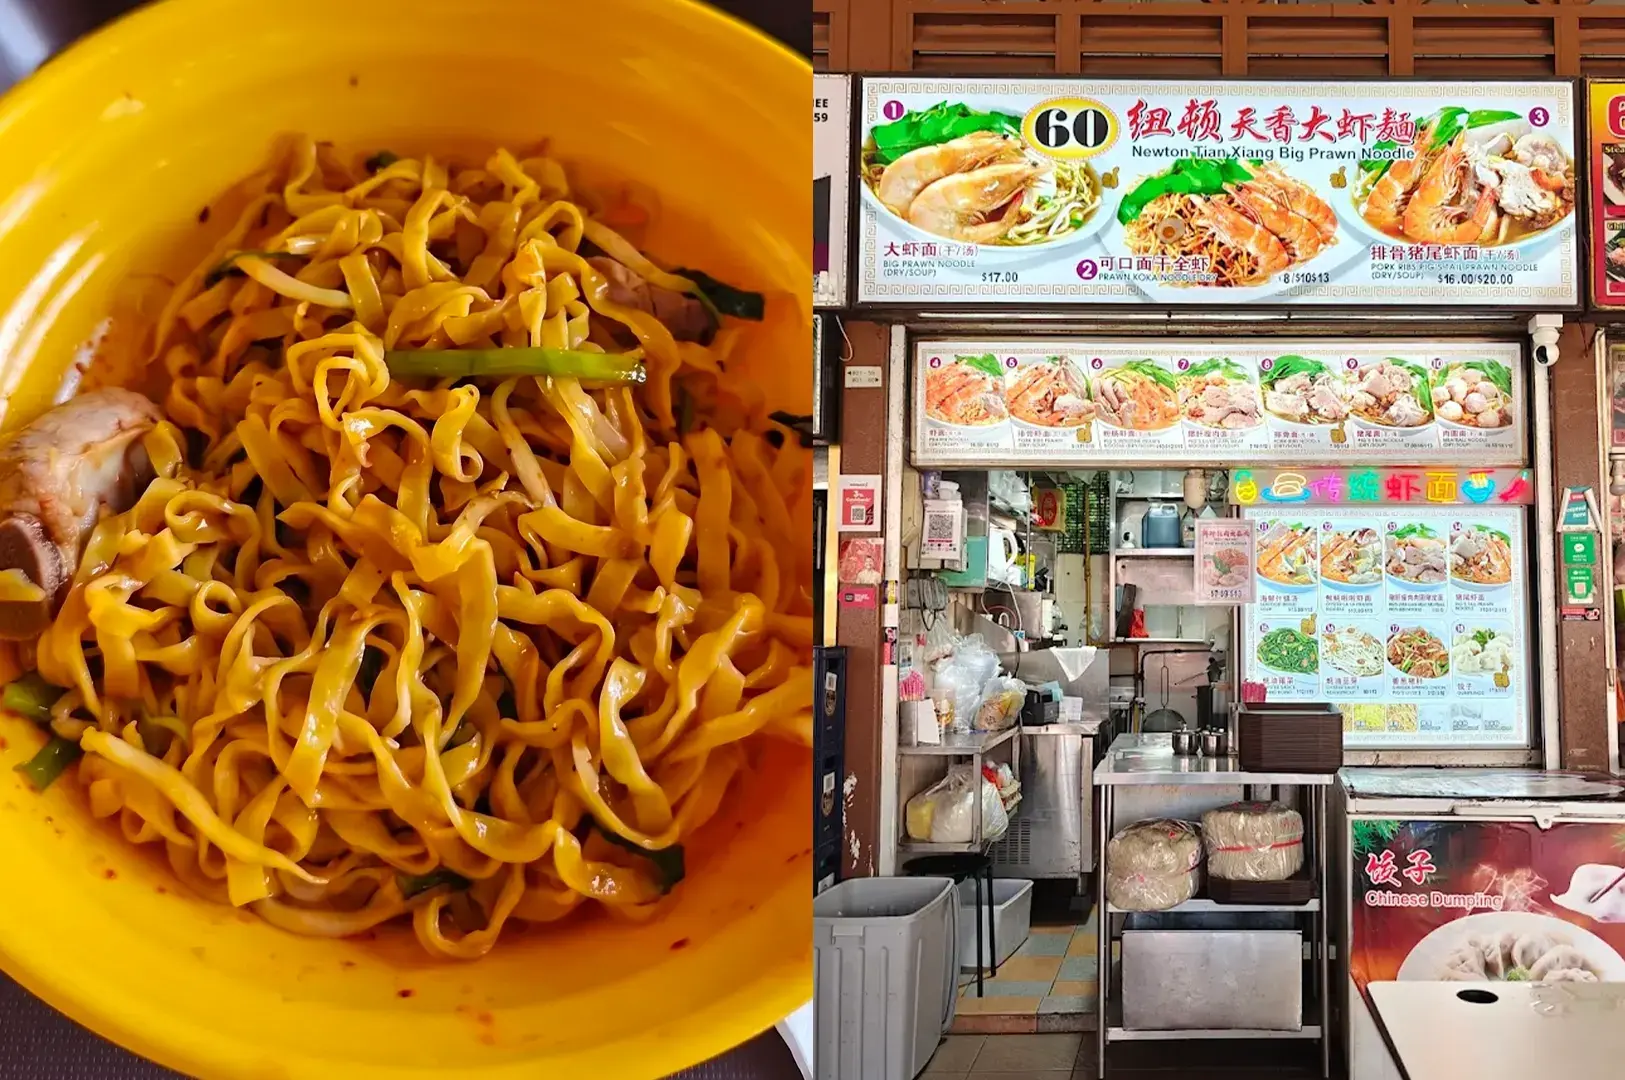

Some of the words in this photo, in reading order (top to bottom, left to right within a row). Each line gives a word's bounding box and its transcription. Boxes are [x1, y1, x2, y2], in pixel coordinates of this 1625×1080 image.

[813, 98, 829, 108] EE
[1034, 108, 1109, 148] 60
[1131, 145, 1189, 158] Newton
[1194, 145, 1227, 160] Tian
[1231, 145, 1275, 162] Xiang
[1279, 146, 1304, 162] Big
[1309, 147, 1357, 160] Prawn
[1361, 147, 1415, 160] Noodle
[883, 259, 900, 268] BIG
[902, 259, 935, 268] PRAWN
[937, 259, 976, 268] NOODLE
[1371, 263, 1396, 272] PORK
[1398, 263, 1416, 272] RIBS
[1464, 263, 1498, 272] PRAWN
[1500, 263, 1538, 272] NOODLE
[883, 268, 937, 278] (DRY/SOUP)
[981, 271, 1018, 283] $17.00
[1098, 272, 1131, 282] PRAWN
[1133, 272, 1157, 282] KOKA
[1160, 272, 1199, 282] NOODLE
[1371, 271, 1424, 280] (DRY/SOUP)
[1310, 470, 1459, 502] 传统虾面
[1365, 849, 1437, 887] 饺子
[1365, 891, 1429, 908] Chinese
[1430, 891, 1504, 911] Dumpling
